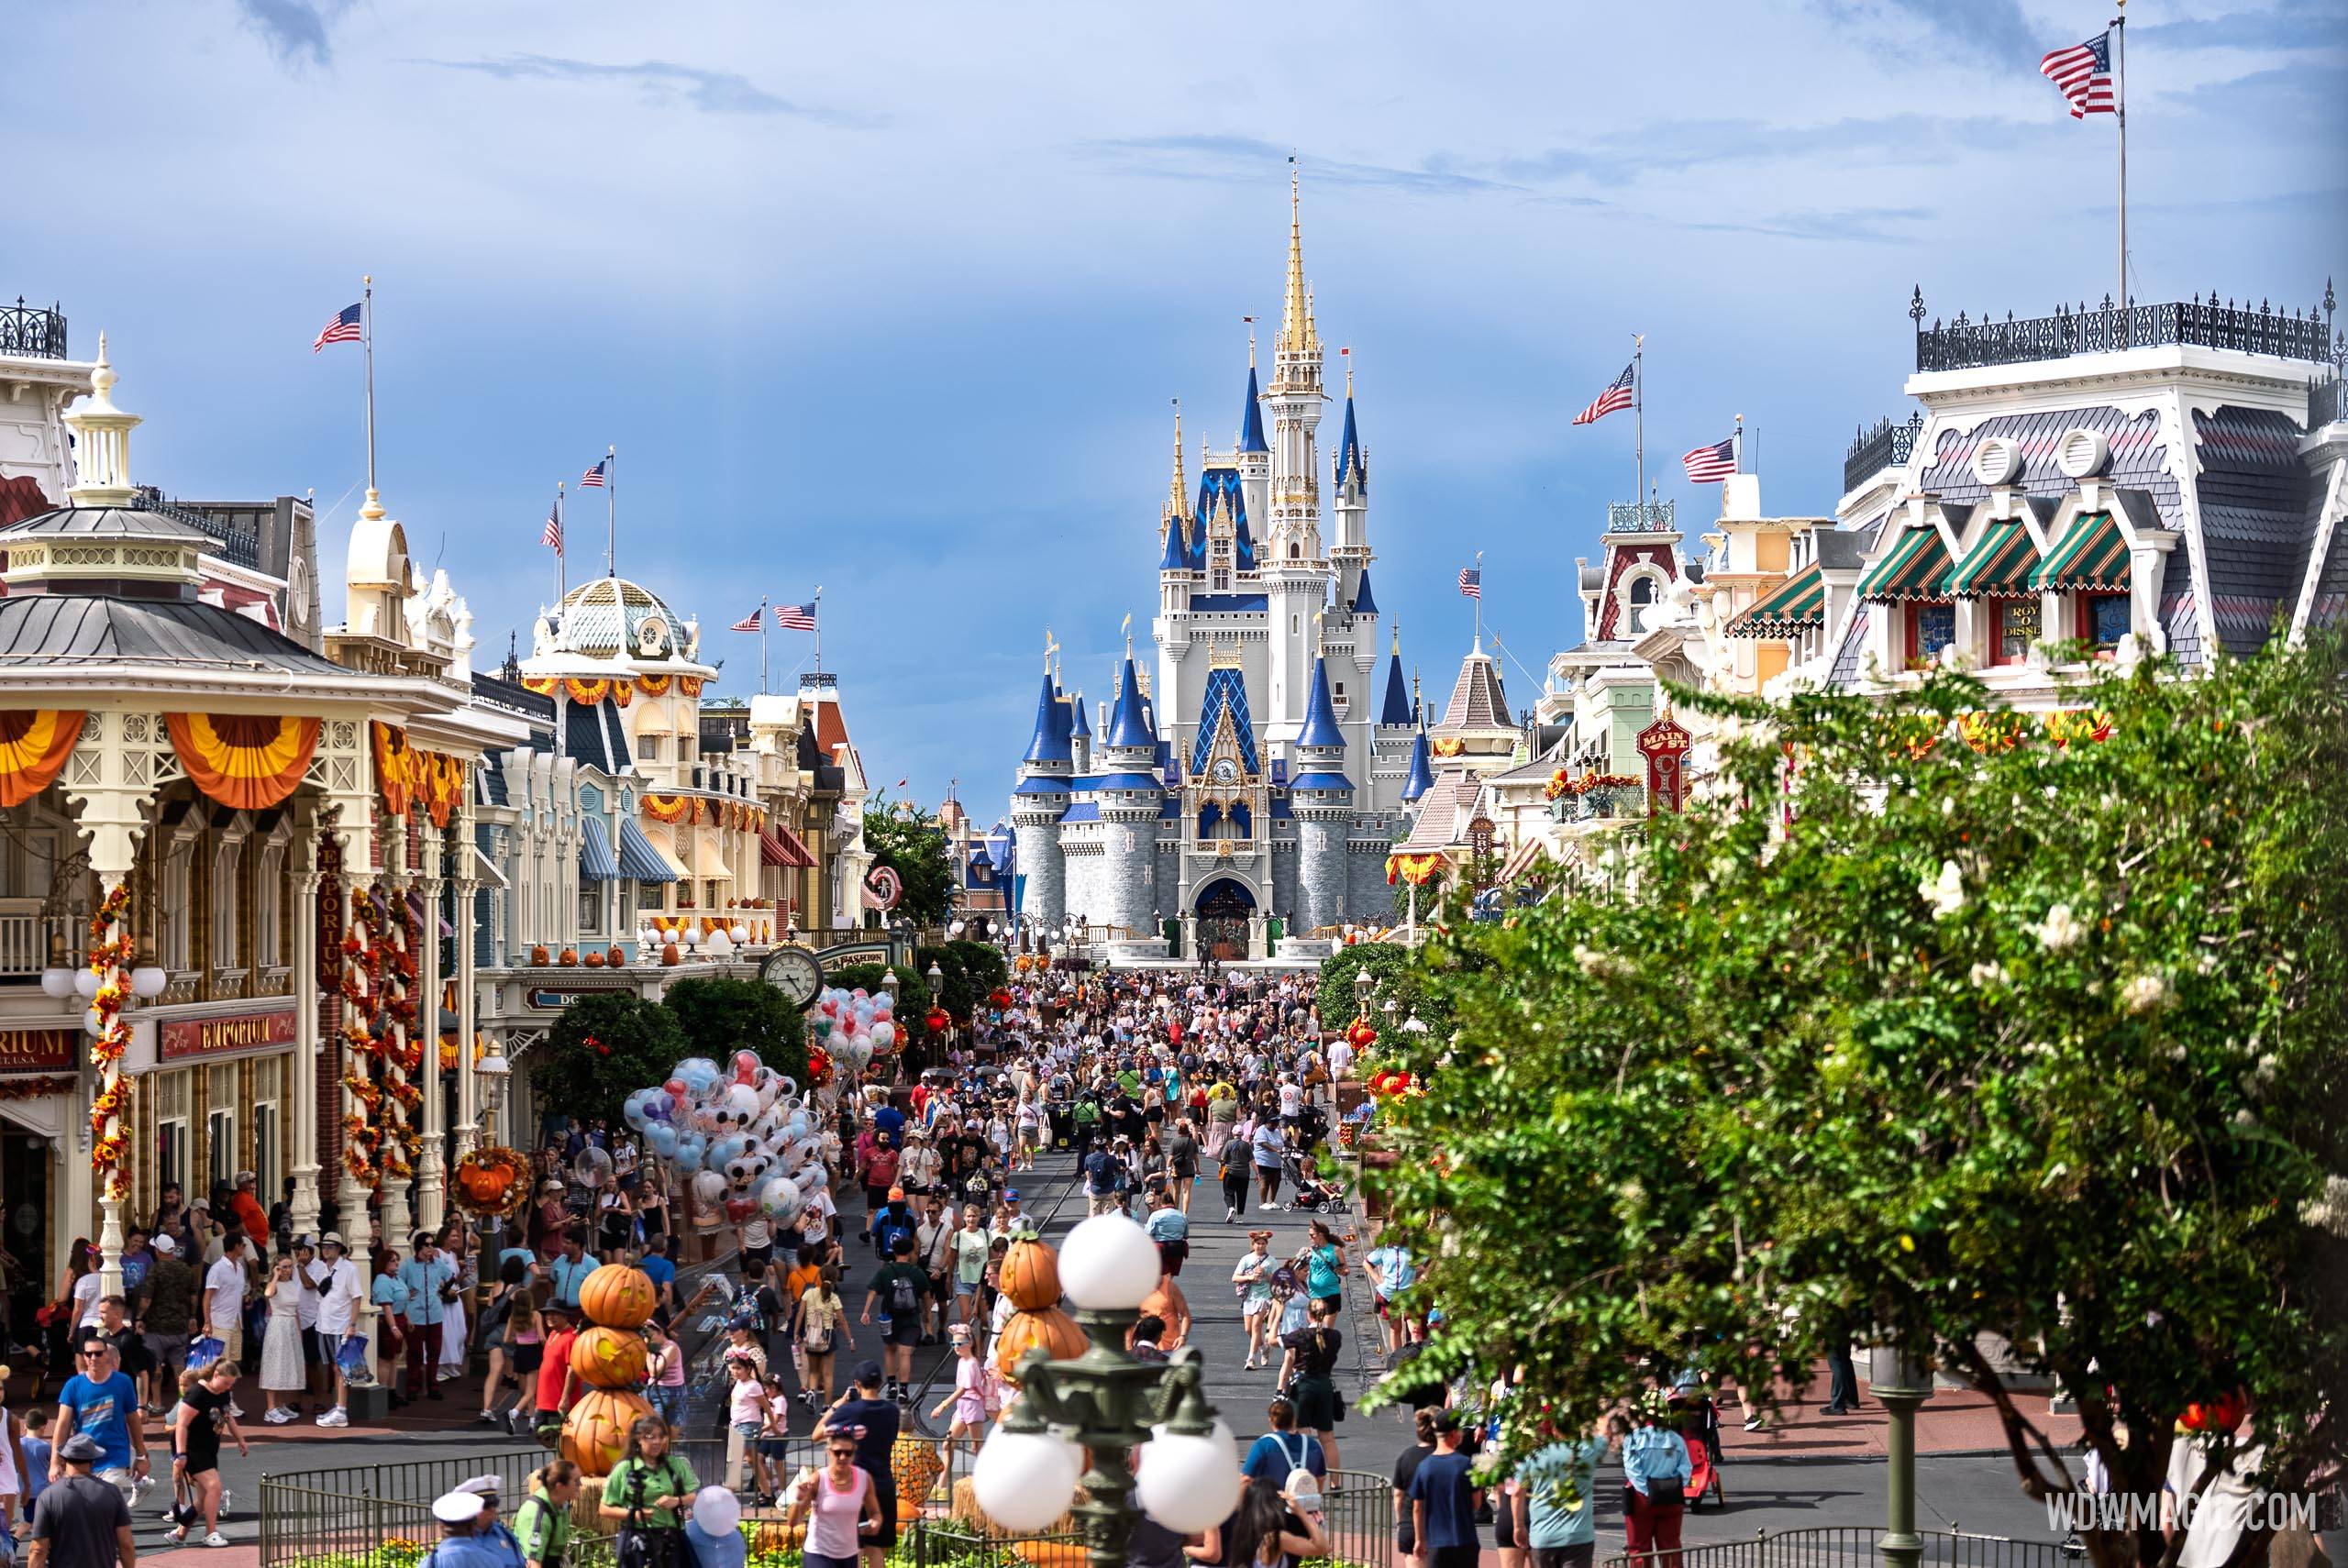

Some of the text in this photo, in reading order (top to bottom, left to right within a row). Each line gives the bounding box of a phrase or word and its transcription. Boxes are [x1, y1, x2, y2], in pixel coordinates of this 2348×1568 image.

[2012, 606, 2039, 617] ROY
[1643, 732, 1684, 747] MAIN
[1667, 739, 1688, 749] ST.
[322, 849, 340, 976] EMPORIUM
[840, 953, 882, 969] FASHION
[202, 1017, 270, 1049] EMPORIUM
[0, 1055, 38, 1065] T. U.S.A.
